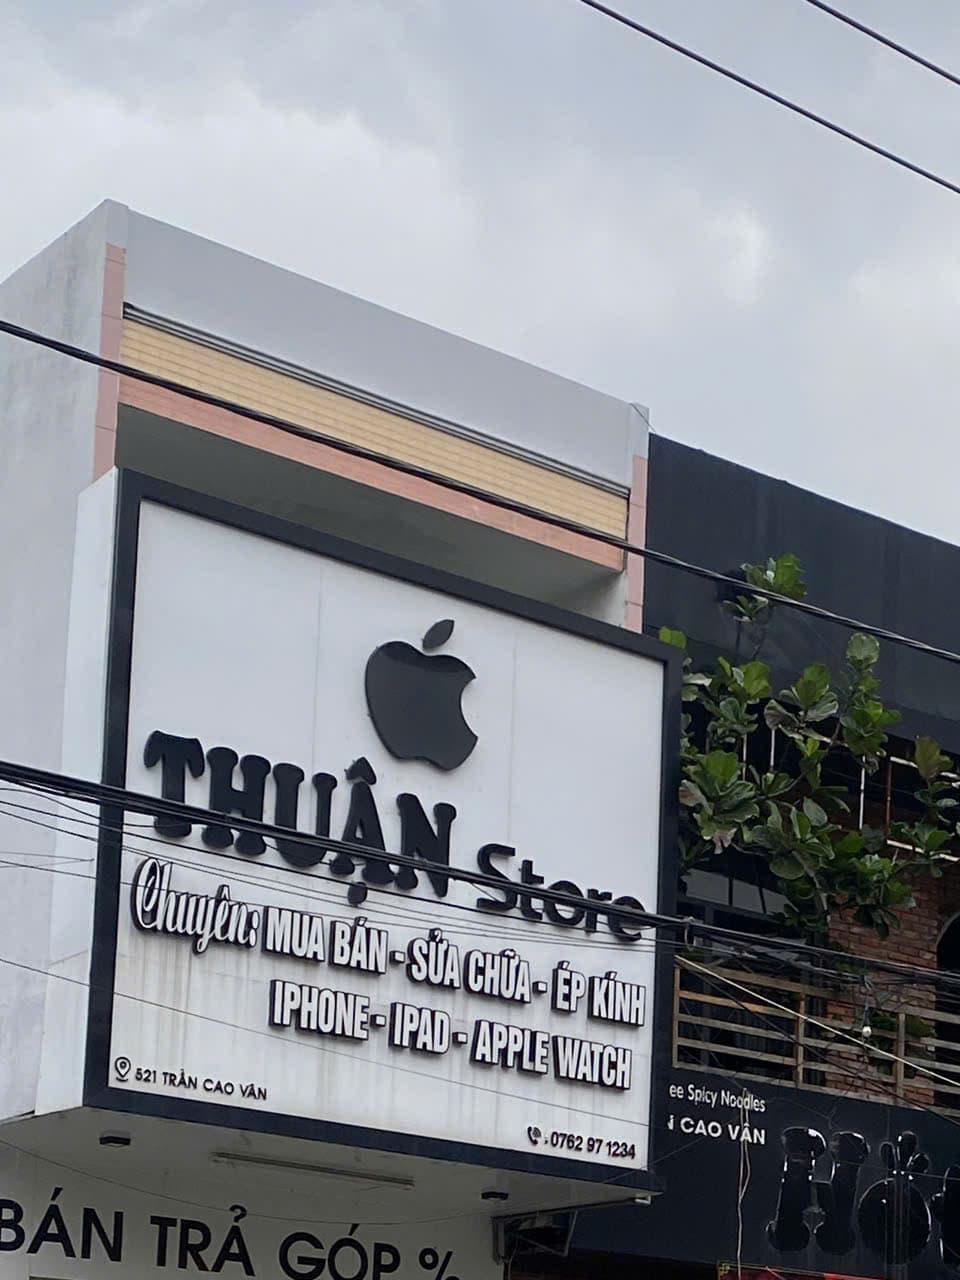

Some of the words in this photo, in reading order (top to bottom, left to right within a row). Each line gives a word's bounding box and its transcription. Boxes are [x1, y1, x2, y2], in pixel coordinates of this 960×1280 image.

[143, 729, 457, 905] THUẬN
[476, 843, 648, 941] Store
[263, 905, 325, 962] MUA
[330, 916, 388, 974] BÁN
[406, 928, 461, 989] SỬA
[464, 949, 532, 1003] CHỮA
[552, 960, 586, 1012] ÉP
[589, 971, 646, 1026] KÍNH
[270, 979, 370, 1040] IPHONE
[389, 1001, 450, 1054] IPAD
[471, 1019, 550, 1074] APPLE
[553, 1035, 632, 1089] WATCH
[135, 1068, 157, 1083] 521
[203, 1078, 235, 1095] CAO
[240, 1083, 267, 1101] VÂN
[688, 1084, 717, 1108] Spicy
[721, 1090, 766, 1112] Noodles
[587, 1137, 602, 1152] 97
[606, 1142, 636, 1160] 1234
[680, 1117, 722, 1138] CAO
[728, 1122, 766, 1145] VÂN
[0, 1187, 124, 1262] BÁN
[150, 1204, 255, 1277] TRẢ
